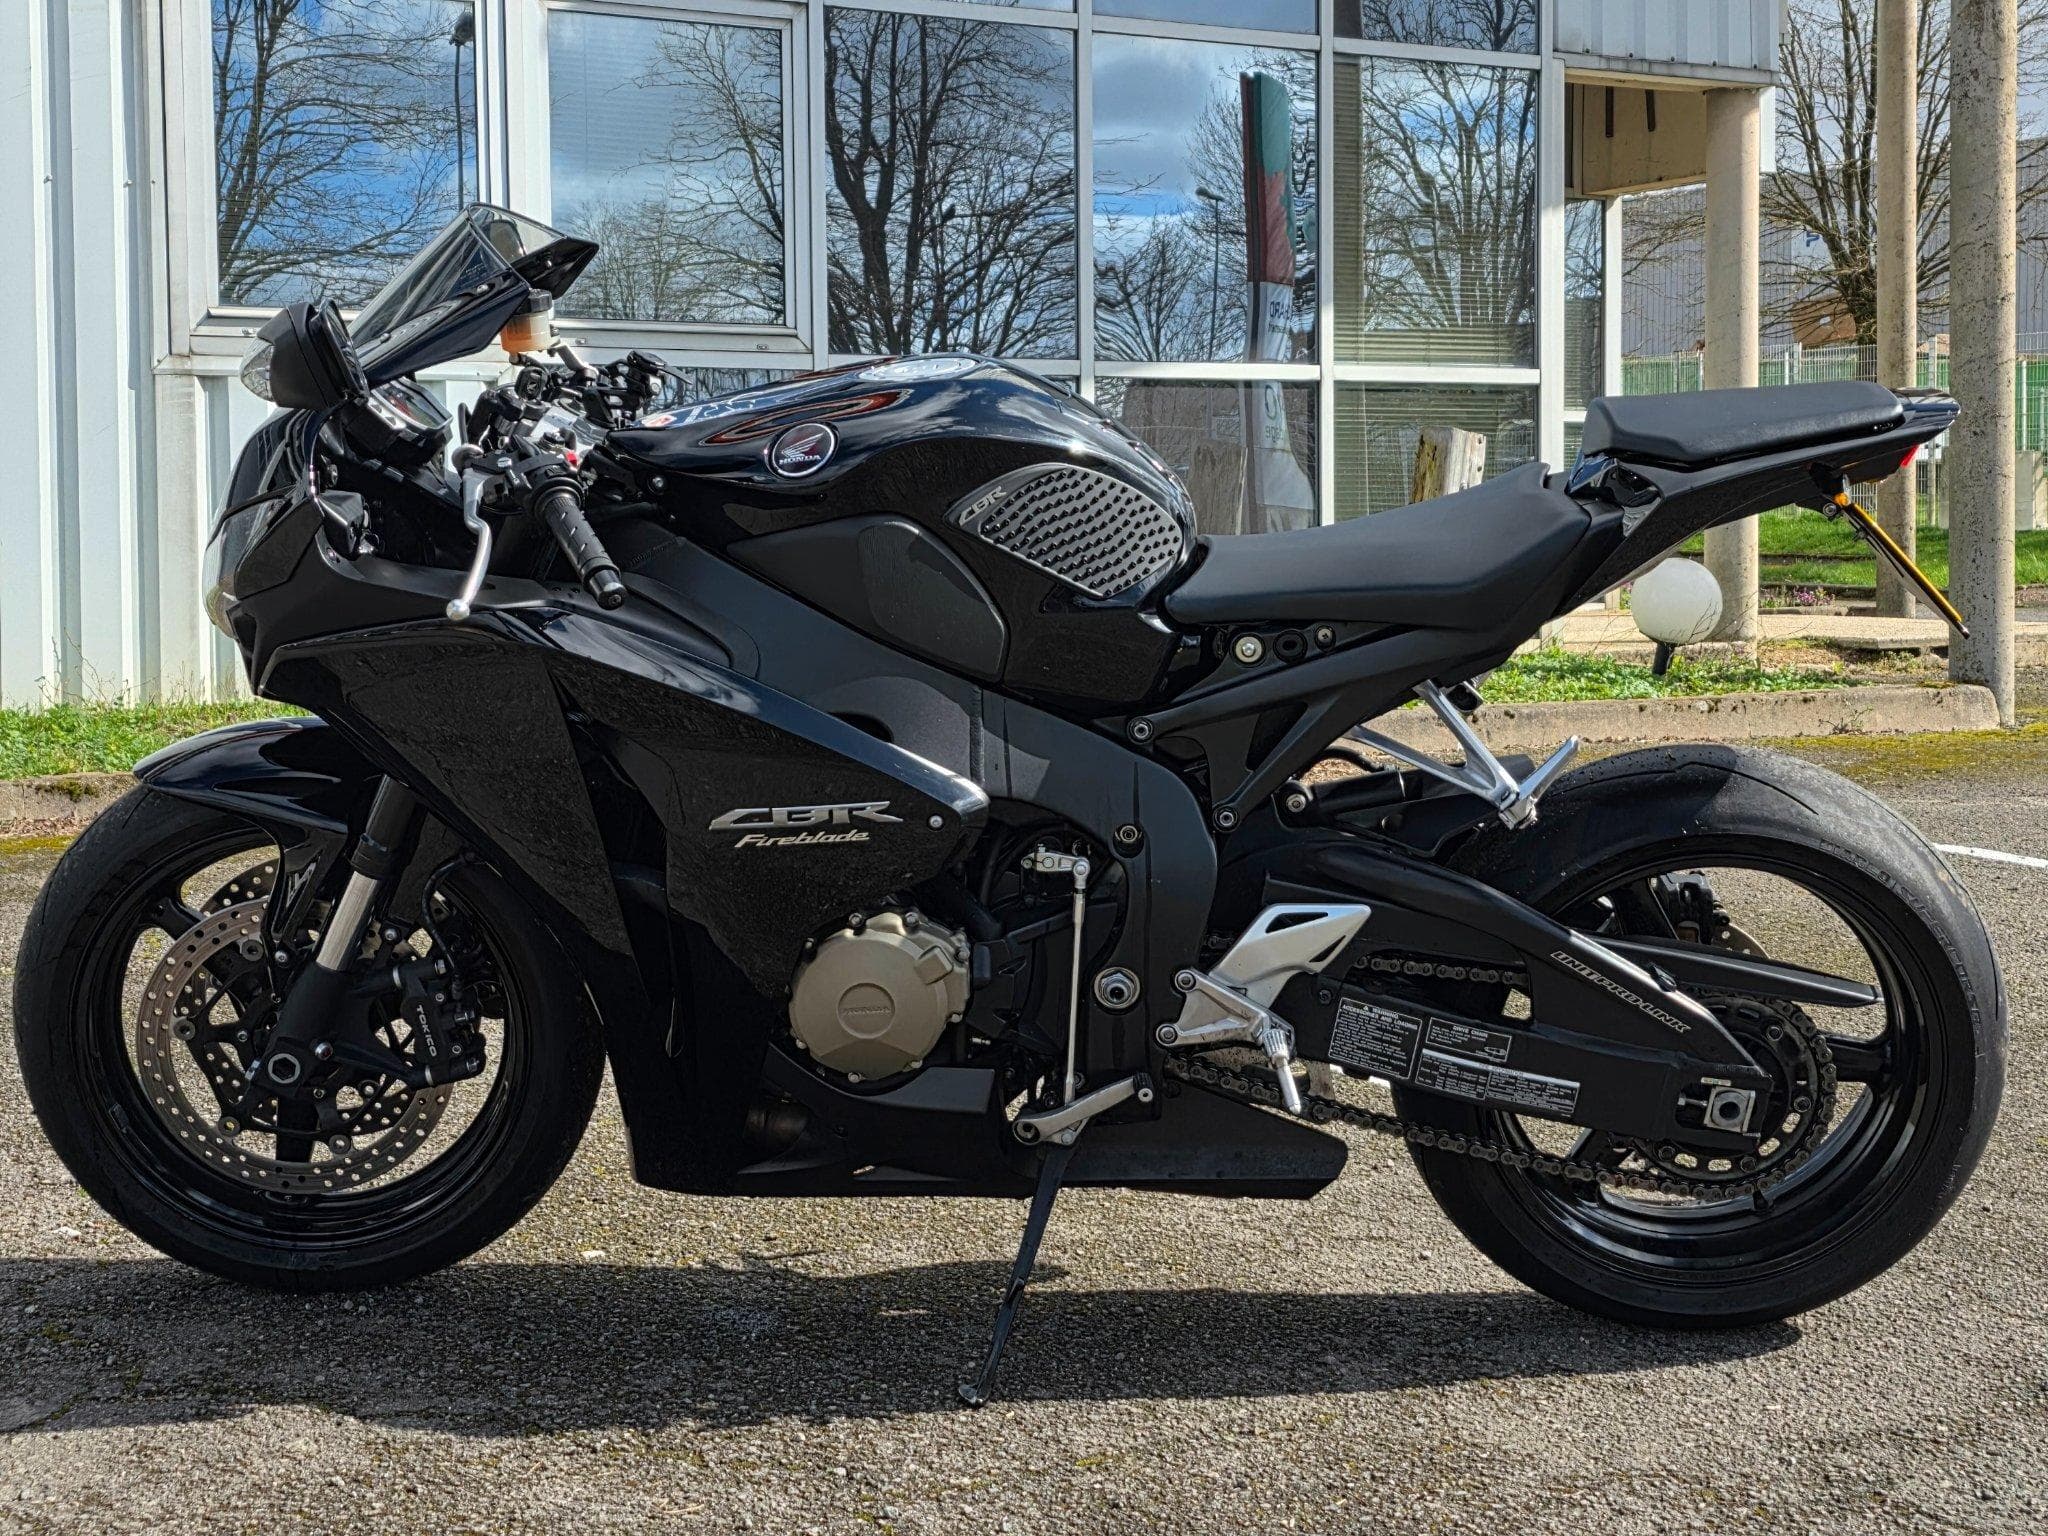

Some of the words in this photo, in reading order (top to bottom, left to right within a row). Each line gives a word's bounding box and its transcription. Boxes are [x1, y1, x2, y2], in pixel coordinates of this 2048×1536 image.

[779, 454, 821, 465] HONDA
[959, 486, 1007, 526] CBR
[709, 801, 903, 830] CBR
[734, 829, 870, 848] Fireblade
[417, 1005, 437, 1056] TOKICO
